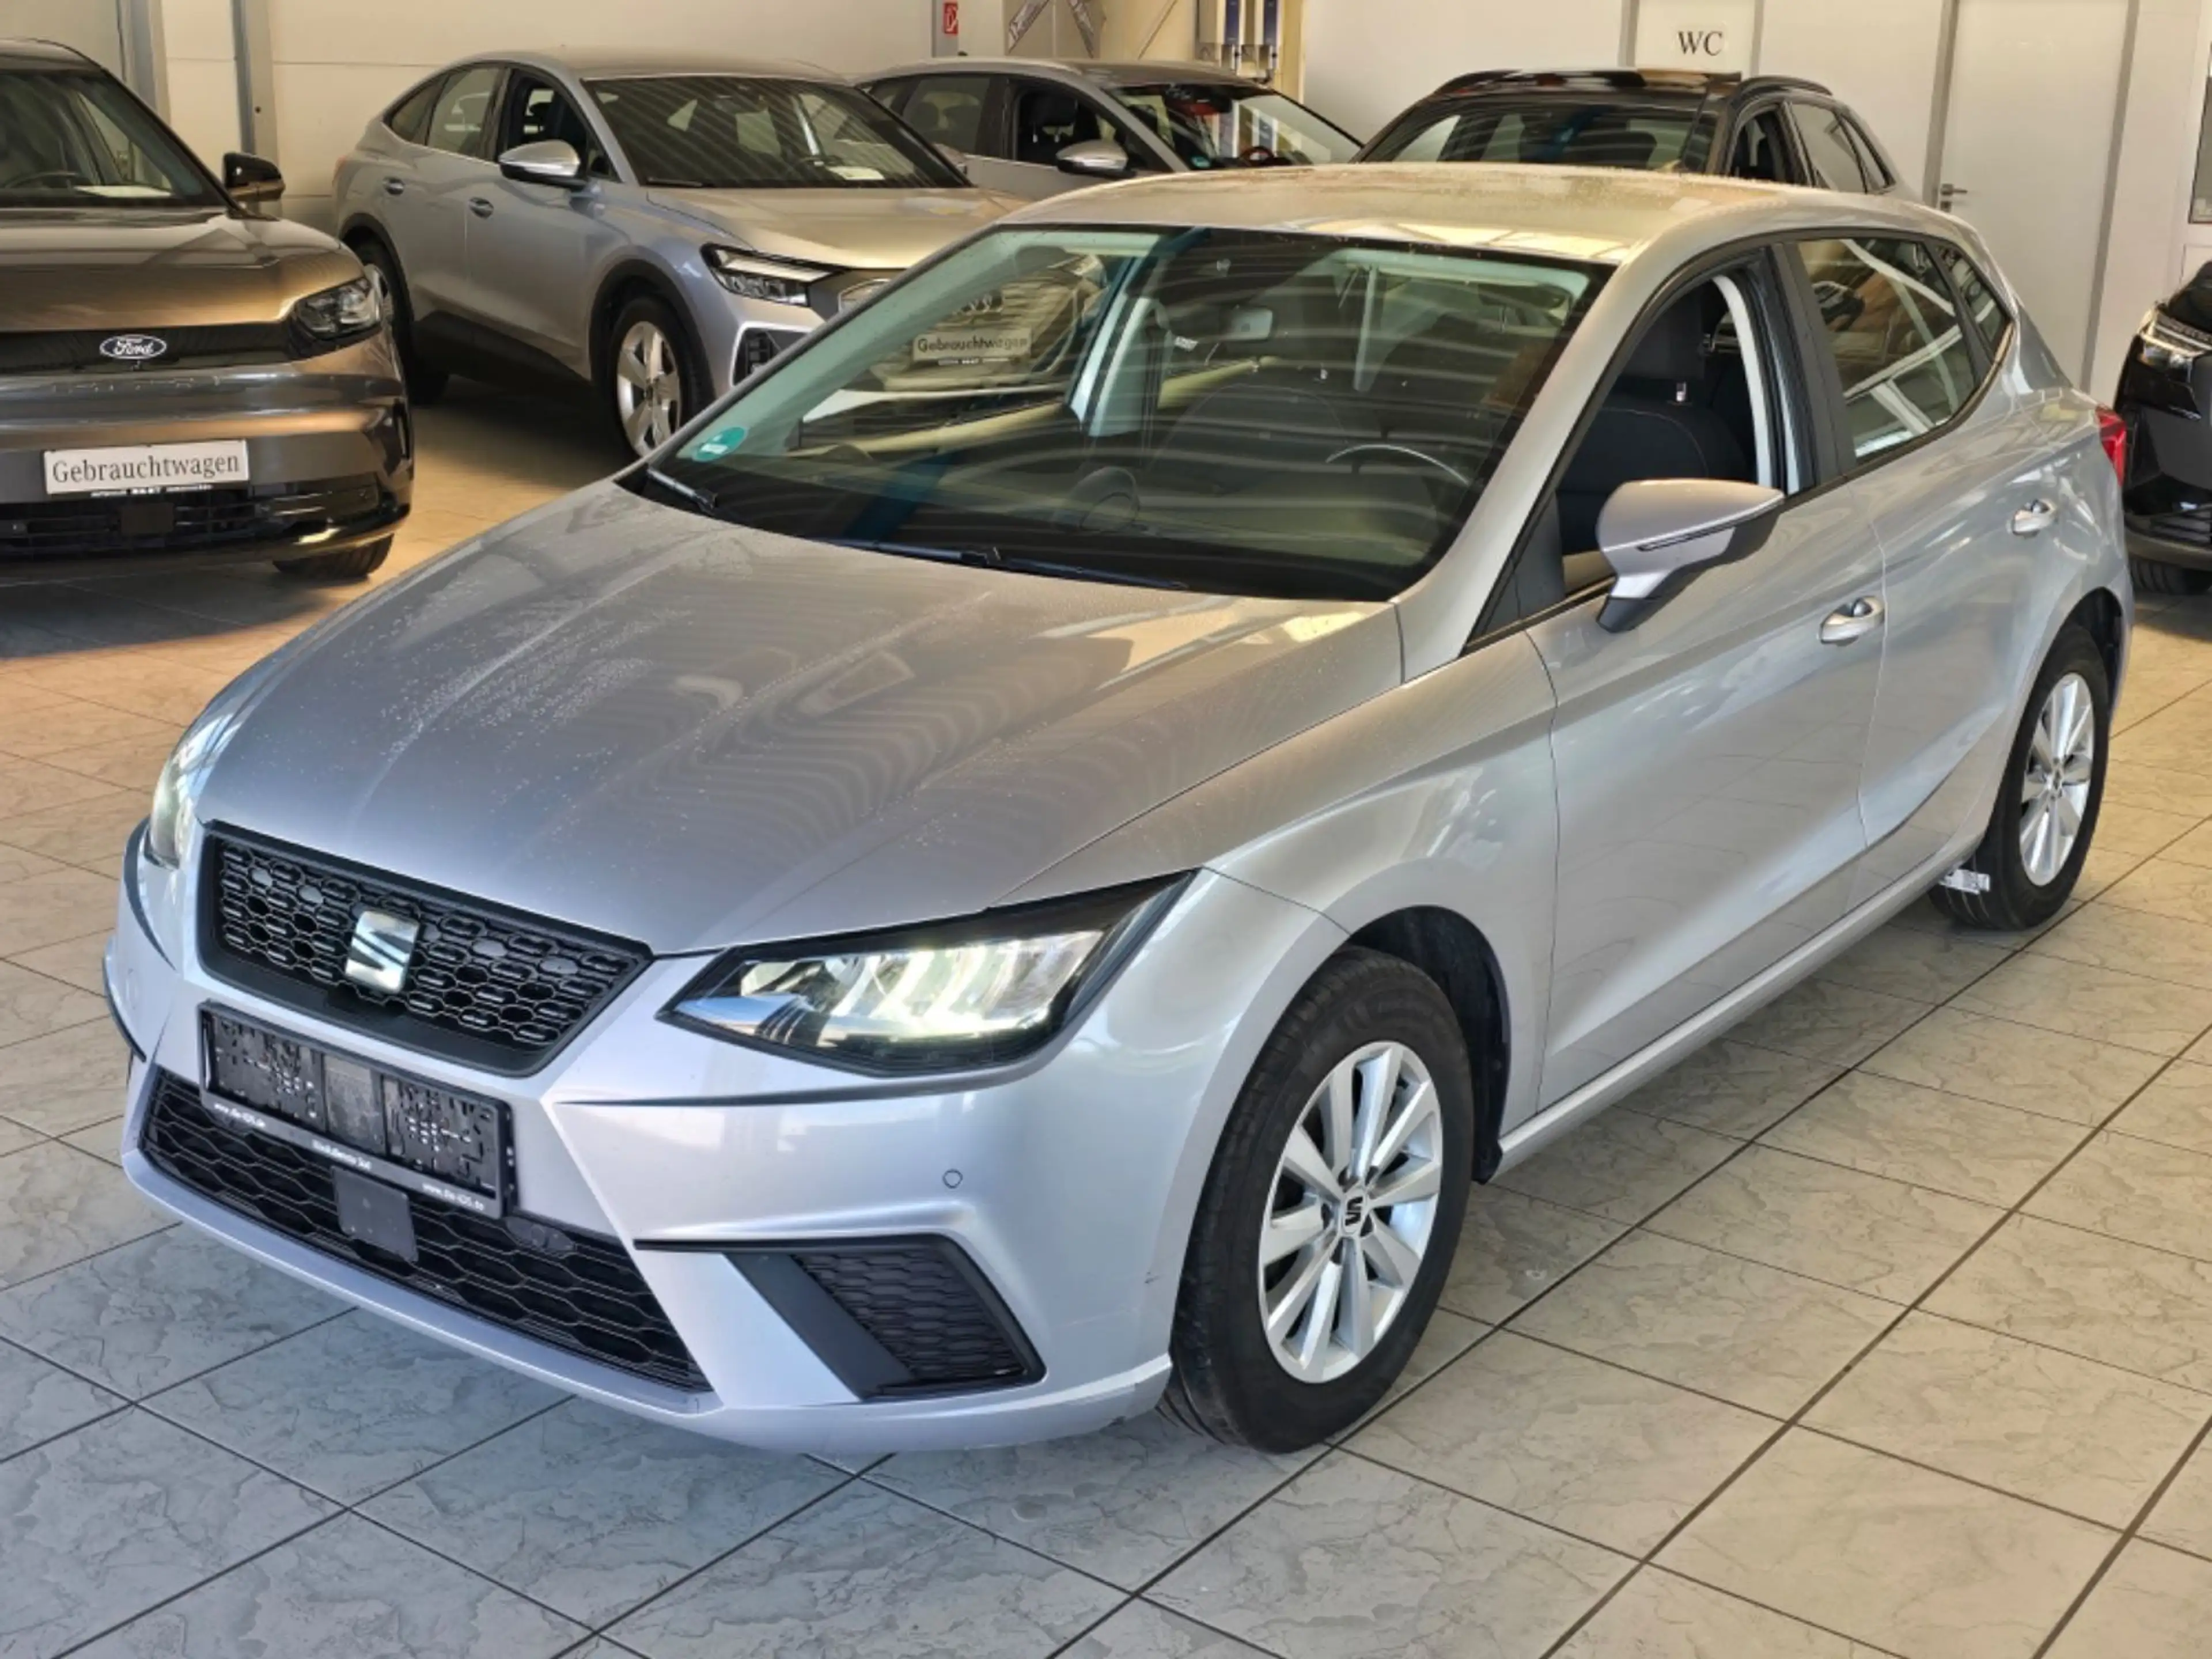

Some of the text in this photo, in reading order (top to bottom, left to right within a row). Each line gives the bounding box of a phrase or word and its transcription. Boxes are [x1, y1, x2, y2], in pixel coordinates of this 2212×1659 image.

[1677, 31, 1723, 56] WC
[113, 340, 154, 355] Ford
[52, 455, 240, 483] Gebrauchtwagen
